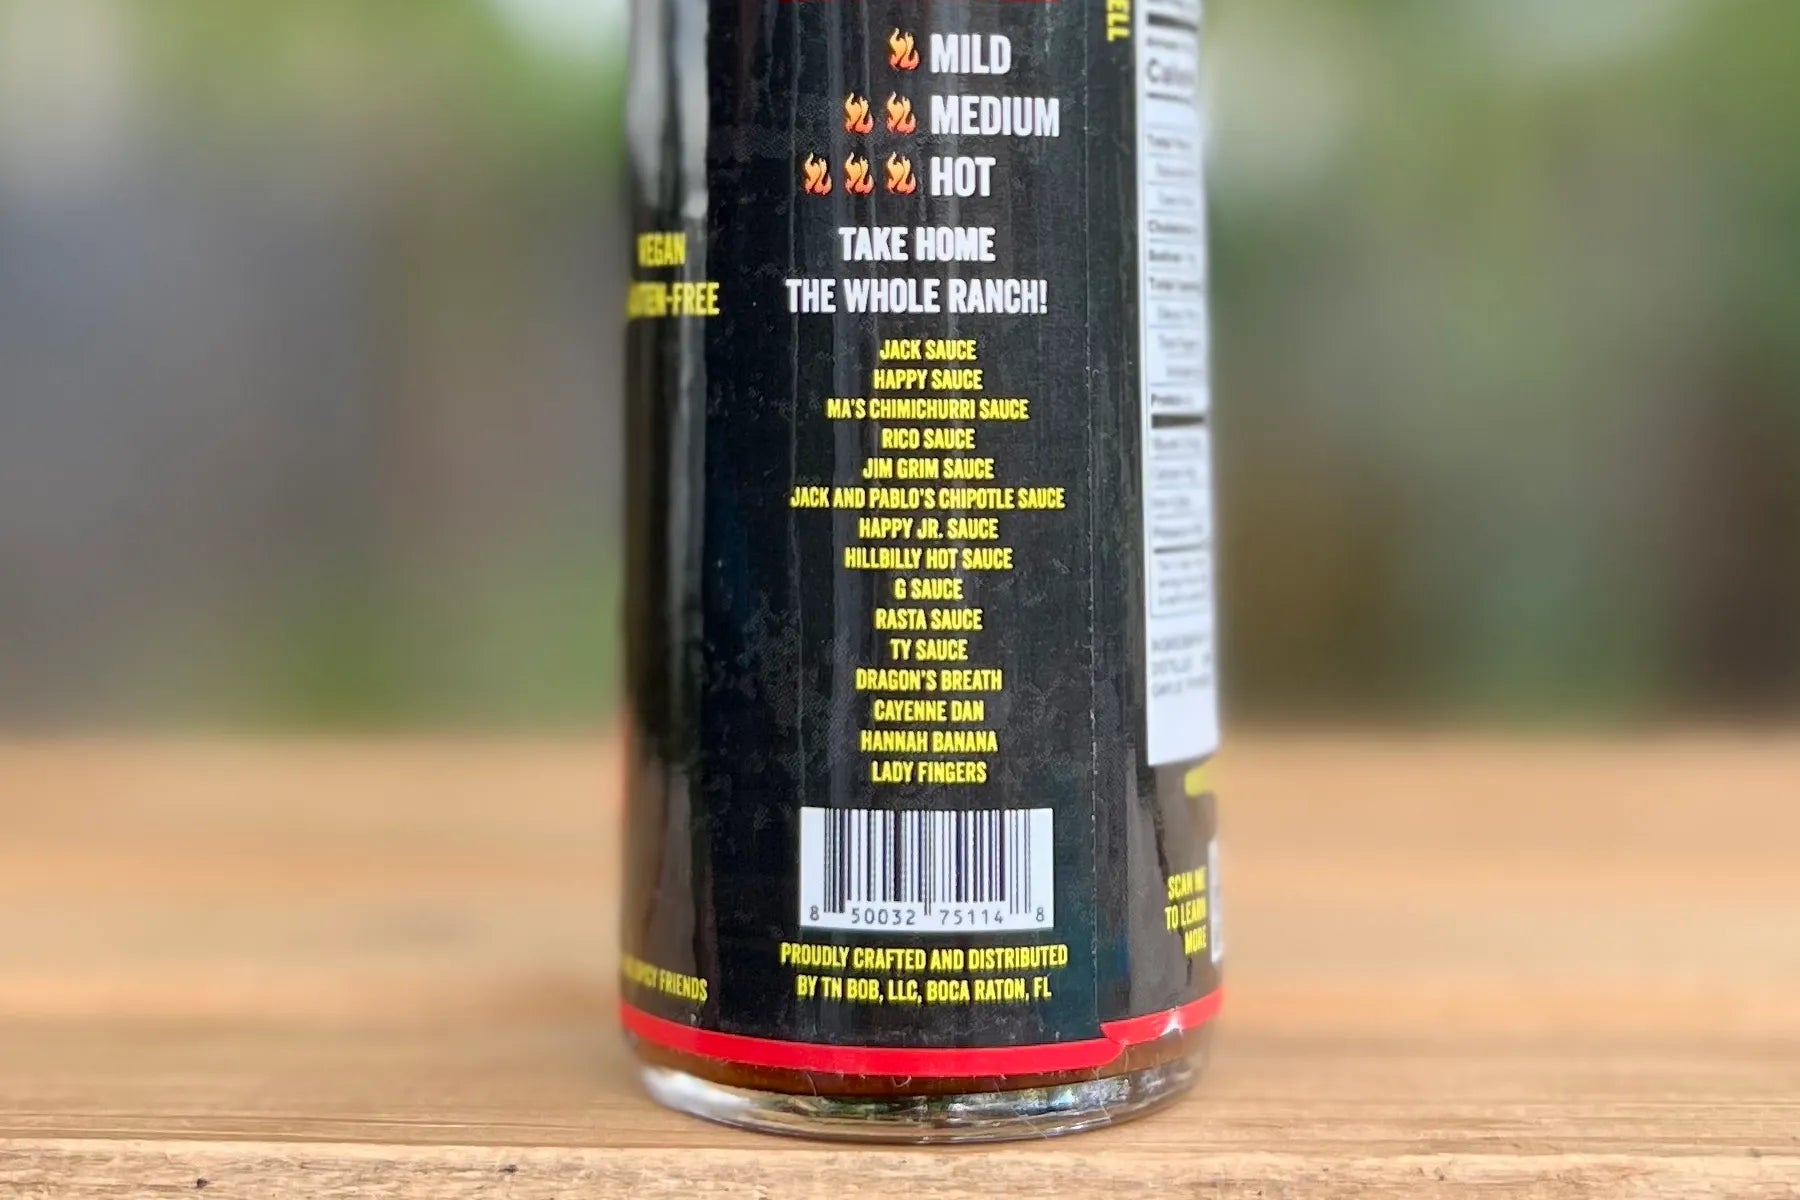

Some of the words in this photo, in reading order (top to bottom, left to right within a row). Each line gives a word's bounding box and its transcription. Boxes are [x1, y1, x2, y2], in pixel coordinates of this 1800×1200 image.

[930, 33, 1012, 75] MILD
[930, 94, 1060, 138] MEDIUM
[930, 156, 997, 197] HOT
[838, 226, 909, 261] TAKE
[915, 226, 996, 262] HOME
[785, 278, 837, 314] THE
[842, 277, 941, 314] WHOLE
[947, 278, 1048, 314] RANCH!
[879, 339, 922, 360] JACK
[925, 339, 977, 360] SAUCE
[873, 368, 928, 390] HAPPY
[931, 368, 983, 390] SAUCE
[827, 398, 866, 420] MA'S
[869, 397, 976, 420] CHIMICHURRI
[979, 398, 1030, 420] SAUCE
[881, 427, 920, 450] RICO
[923, 427, 976, 450] SAUCE
[863, 457, 893, 480] JIM
[896, 457, 939, 480] GRIM
[943, 457, 995, 480] SAUCE
[790, 486, 829, 508] JACK
[832, 486, 866, 509] AND
[869, 486, 936, 510] PABLO'S
[939, 486, 1015, 510] CHIPOTLE
[1017, 486, 1066, 510] SAUCE
[858, 516, 913, 540] HAPPY
[916, 516, 944, 540] JR.
[947, 516, 998, 540] SAUCE
[844, 547, 922, 570] HILLBILLY
[925, 547, 959, 570] HOT
[962, 547, 1013, 570] SAUCE
[893, 578, 907, 600] G
[910, 578, 963, 601] SAUCE
[875, 608, 927, 631] RASTA
[930, 608, 983, 631] SAUCE
[889, 638, 912, 661] TY
[915, 638, 968, 661] SAUCE
[855, 668, 938, 692] DRAGON'S
[940, 668, 1003, 692] BREATH
[873, 698, 947, 723] CAYENNE
[950, 699, 985, 723] DAN
[860, 730, 929, 753] HANNAH
[931, 730, 999, 753] BANANA
[871, 760, 914, 784] LADY
[917, 760, 988, 784] FINGERS
[1167, 870, 1193, 900] SCAN
[809, 903, 820, 922] 8
[851, 907, 916, 926] 50032
[938, 908, 1005, 926] 75114
[1035, 906, 1046, 923] 8
[1164, 903, 1179, 930] TO
[1184, 924, 1208, 956] MORE
[780, 943, 849, 969] PROUDLY
[852, 946, 927, 971] CRAFTED
[929, 948, 965, 972] AND
[967, 944, 1069, 972] DISTRIBUTED
[659, 968, 708, 1002] FRIENDS
[796, 974, 818, 998] BY
[820, 976, 843, 999] TN
[846, 977, 884, 1003] BOB,
[887, 978, 922, 1004] LLC,
[926, 978, 971, 1003] BOCA
[974, 977, 1030, 1003] RATON,
[1032, 976, 1053, 999] FL
